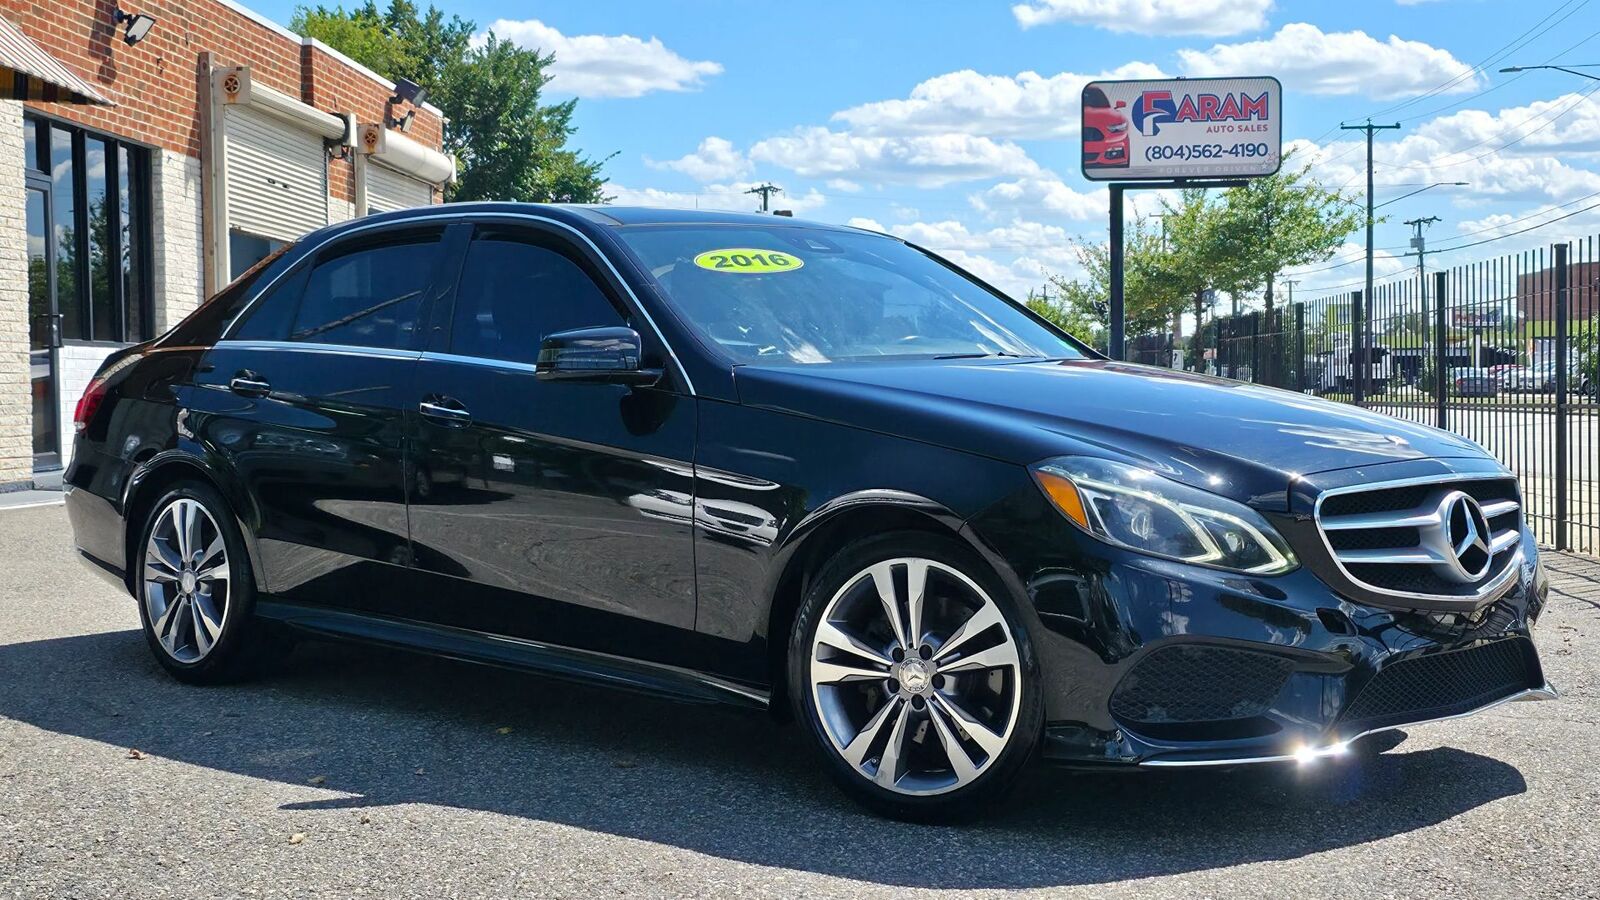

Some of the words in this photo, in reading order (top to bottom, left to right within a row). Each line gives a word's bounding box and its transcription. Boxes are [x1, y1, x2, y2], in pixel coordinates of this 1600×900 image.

[1206, 125, 1235, 134] AUTO
[1237, 124, 1269, 133] SALES
[1145, 143, 1268, 162] (804)562-4190
[1215, 165, 1257, 173] DRIVEN
[710, 254, 790, 268] 2016
